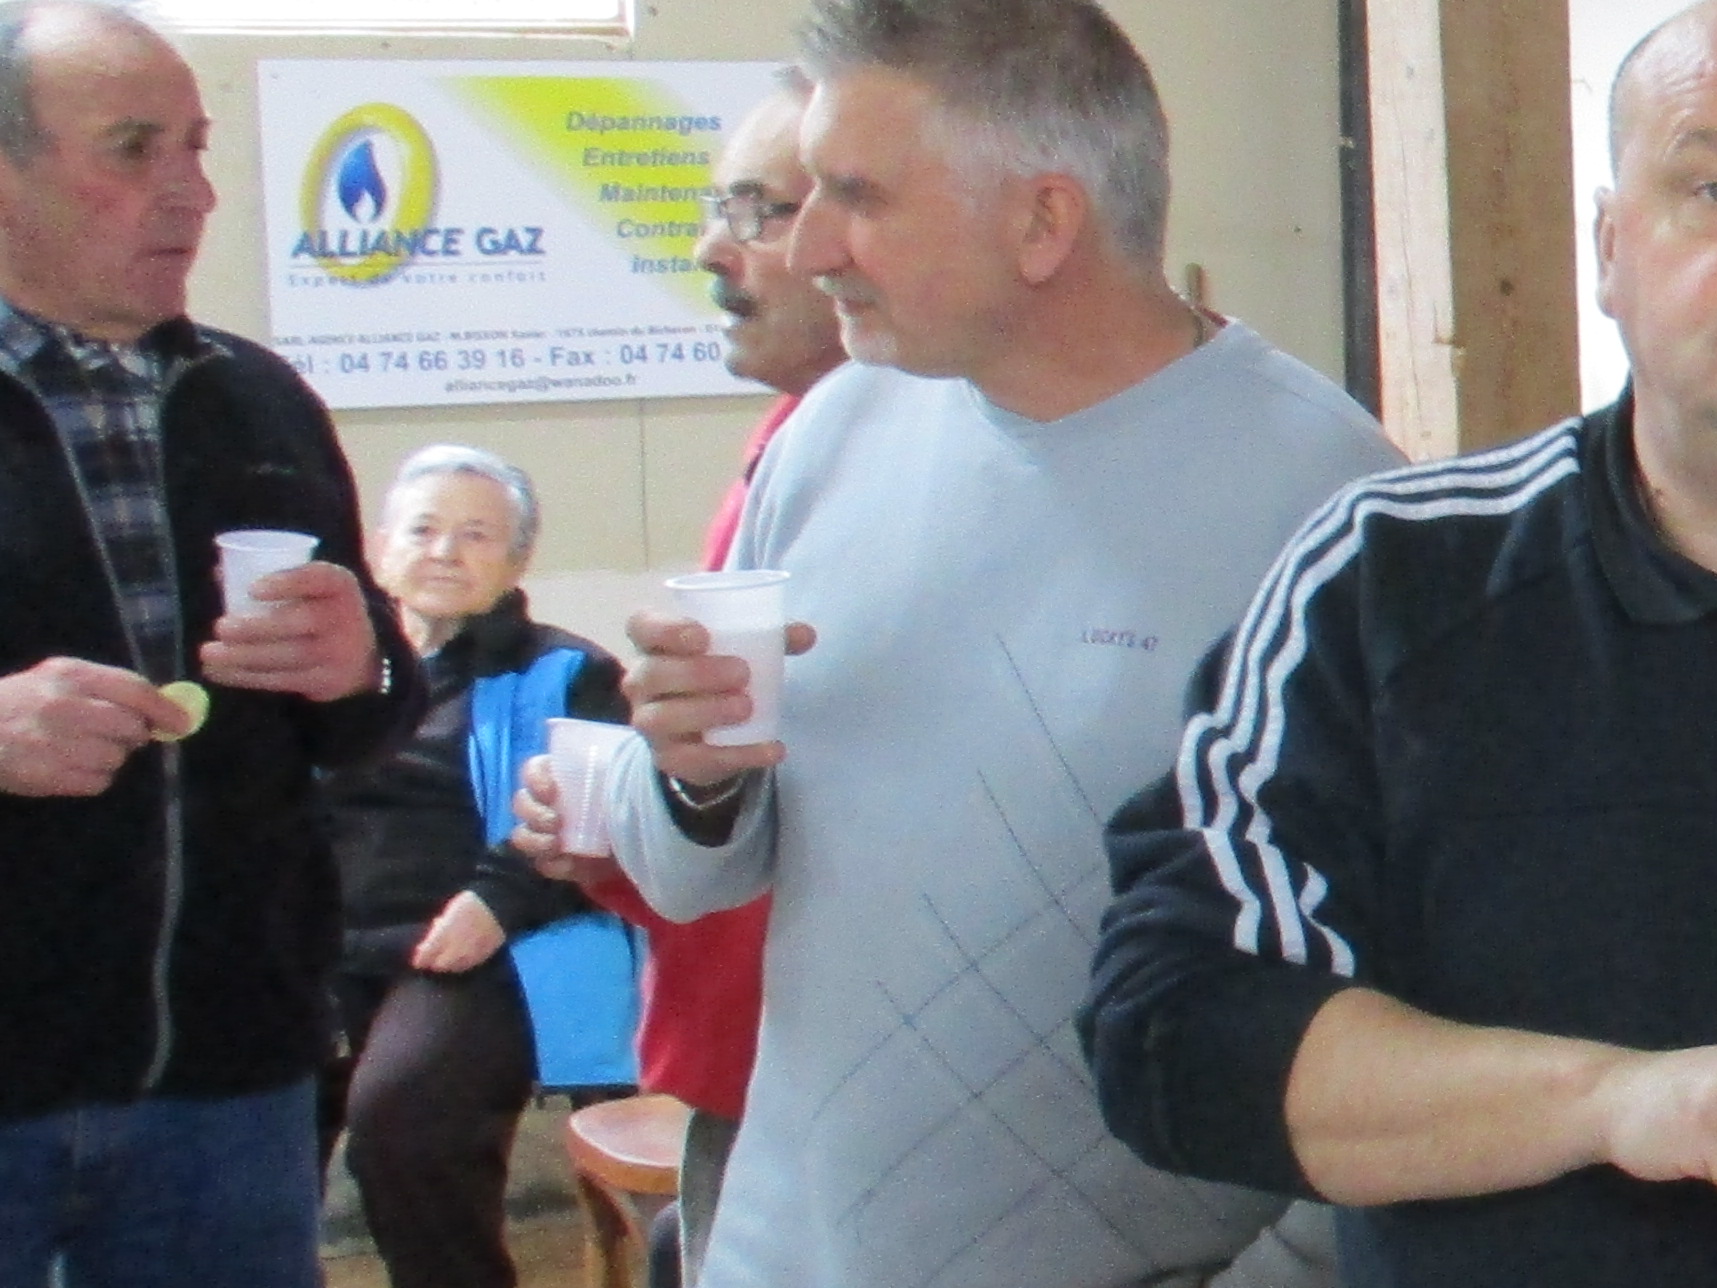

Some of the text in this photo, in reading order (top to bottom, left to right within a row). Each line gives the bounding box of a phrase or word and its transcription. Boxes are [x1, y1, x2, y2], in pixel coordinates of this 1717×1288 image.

[583, 147, 710, 167] Entretiens
[616, 219, 700, 238] Contra
[291, 227, 546, 259] ALLIANCE GAZ
[340, 352, 369, 374] 04
[379, 351, 409, 371] 74
[418, 349, 448, 371] 66
[457, 348, 486, 369] 39
[549, 346, 595, 367] Fax
[619, 343, 648, 364] 04
[656, 342, 685, 362] 74
[693, 341, 721, 362] 60
